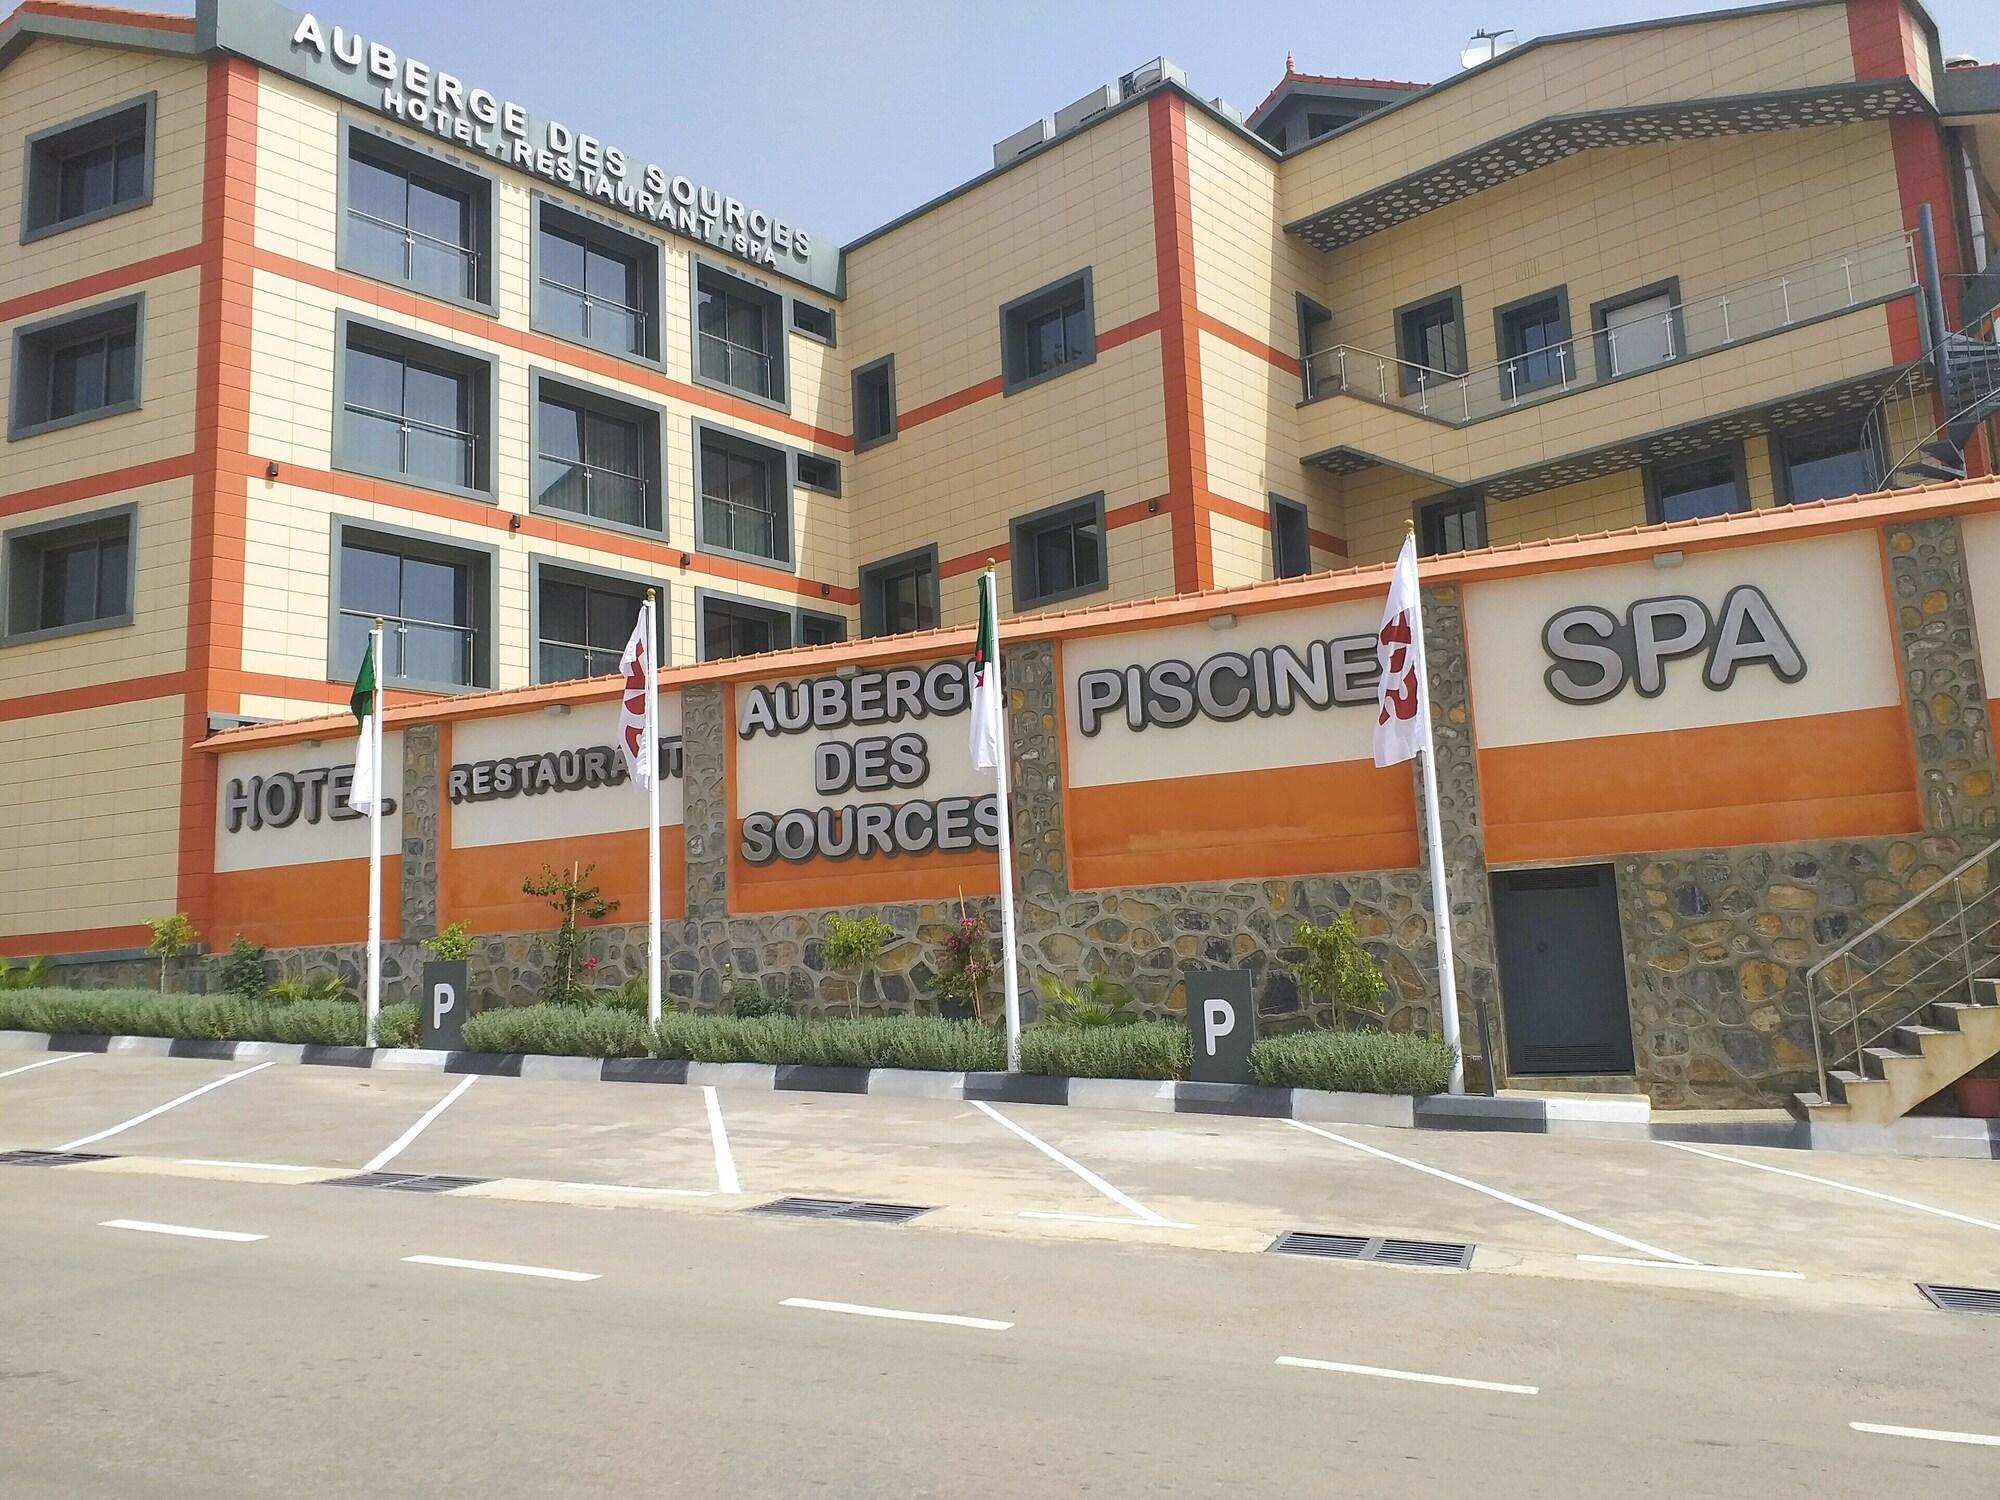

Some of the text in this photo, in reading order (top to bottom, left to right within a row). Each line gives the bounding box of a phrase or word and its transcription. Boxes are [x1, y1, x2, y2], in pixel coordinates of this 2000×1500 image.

[292, 12, 812, 258] AUBERGE DES SOURCES
[383, 86, 489, 150] HOTEL
[512, 137, 716, 240] RESTAURANT
[733, 232, 778, 267] SPA
[1541, 584, 1807, 706] SPA
[738, 656, 1006, 740] AUBERG
[1077, 632, 1383, 738] PISCINE
[225, 764, 398, 833] HOTE
[449, 735, 683, 805] RESTAURAT
[814, 732, 931, 796] DES
[741, 794, 1004, 867] SOURCES
[433, 983, 455, 1030] P
[1203, 998, 1235, 1057] P
